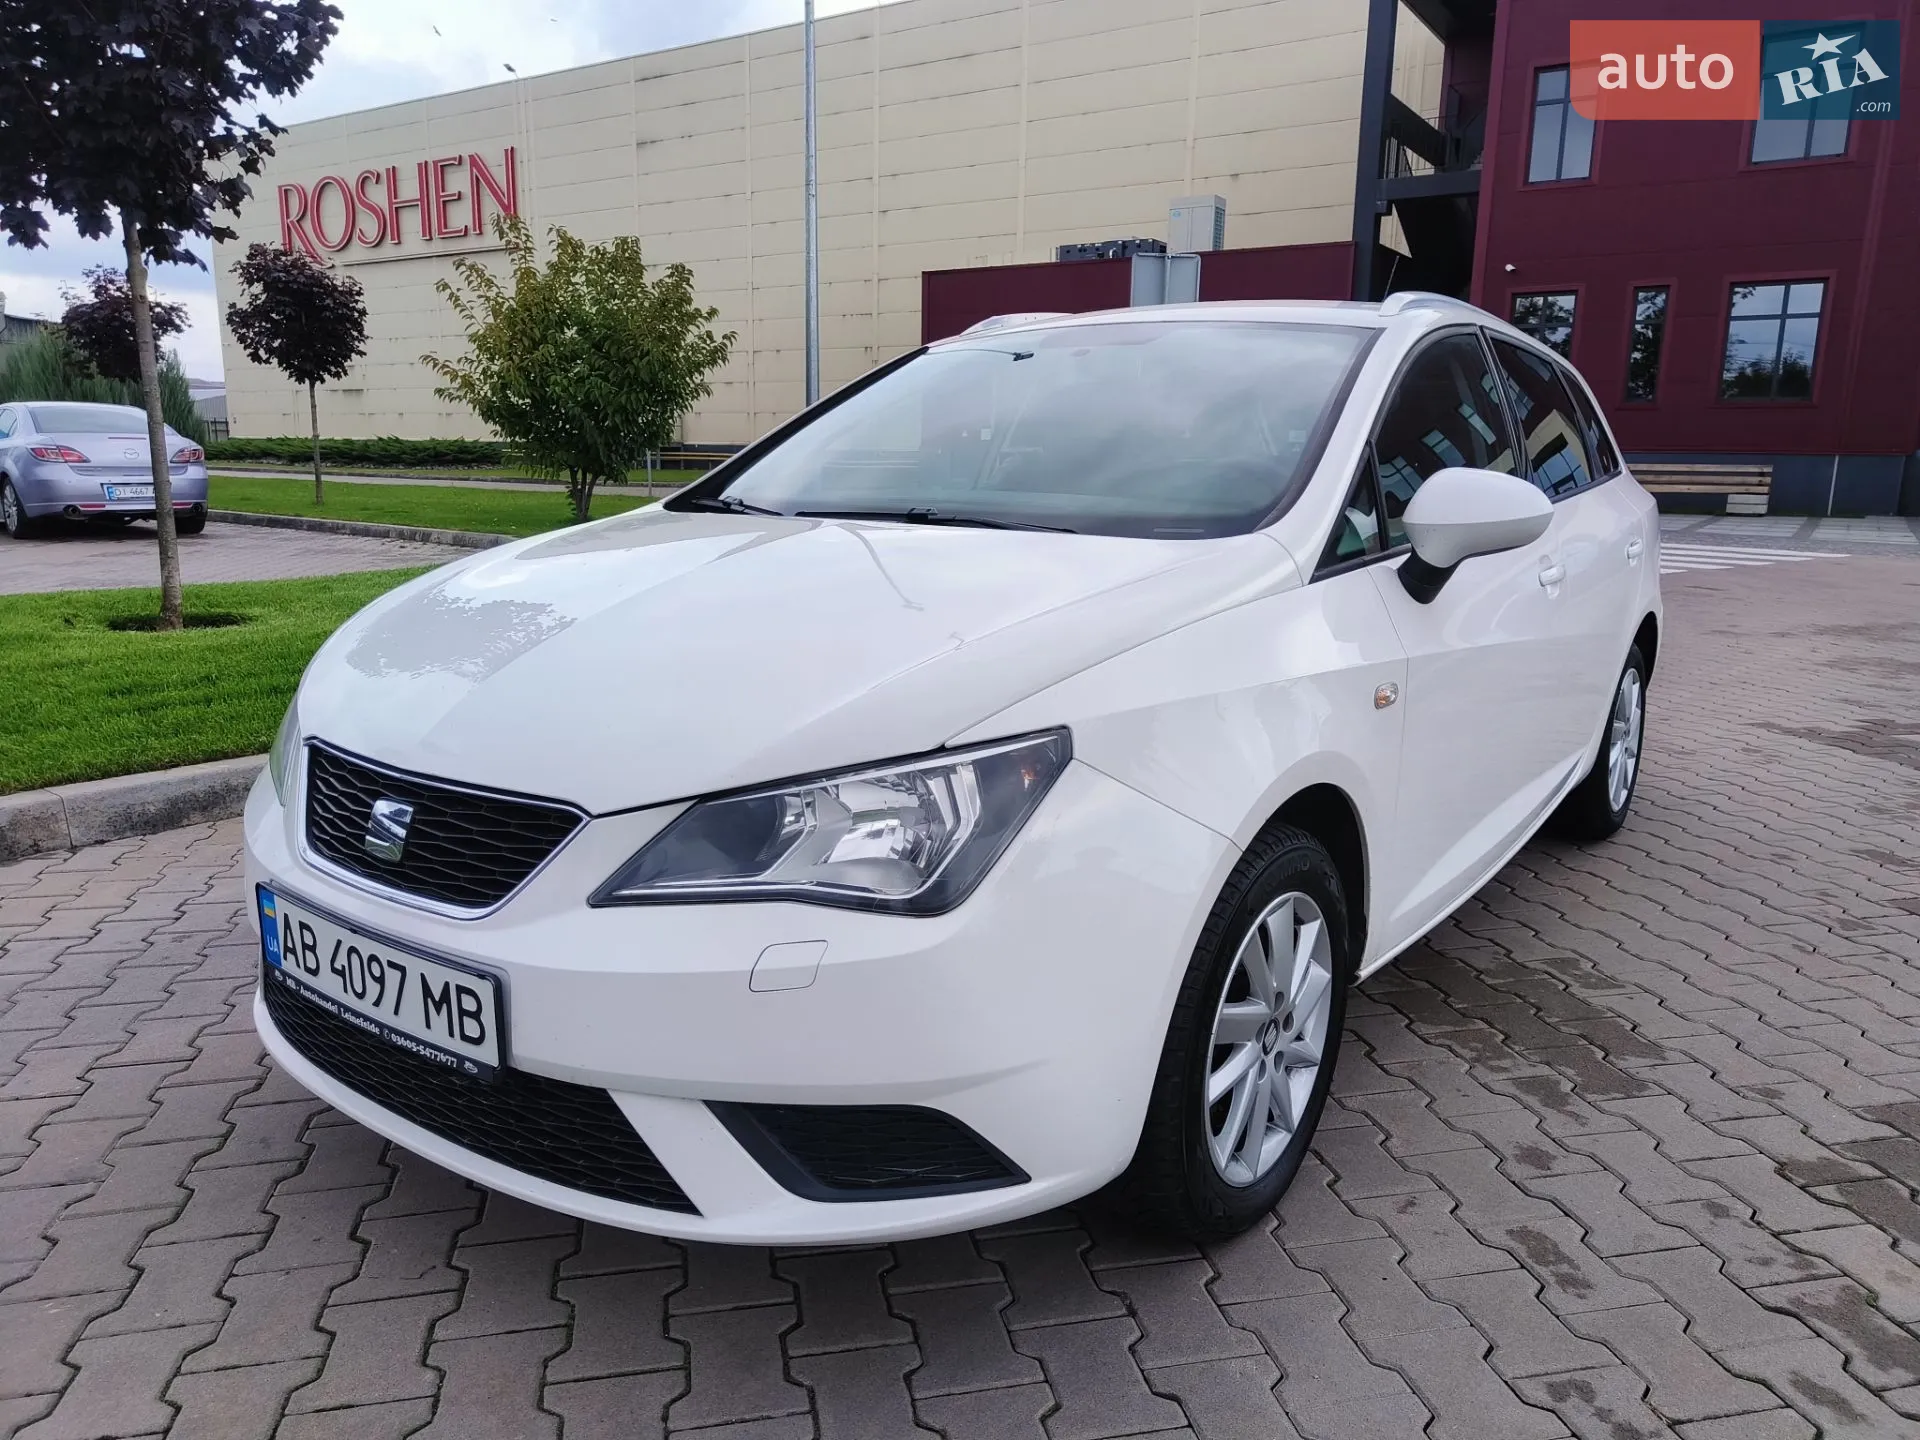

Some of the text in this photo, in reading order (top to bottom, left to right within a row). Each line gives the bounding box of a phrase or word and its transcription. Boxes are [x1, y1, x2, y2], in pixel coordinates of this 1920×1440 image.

[277, 145, 517, 269] ROSHEN
[266, 934, 279, 956] UA
[282, 912, 486, 1046] AB 4097 MB
[300, 985, 339, 1015] Autohandel
[340, 1007, 380, 1035] Leinefelde
